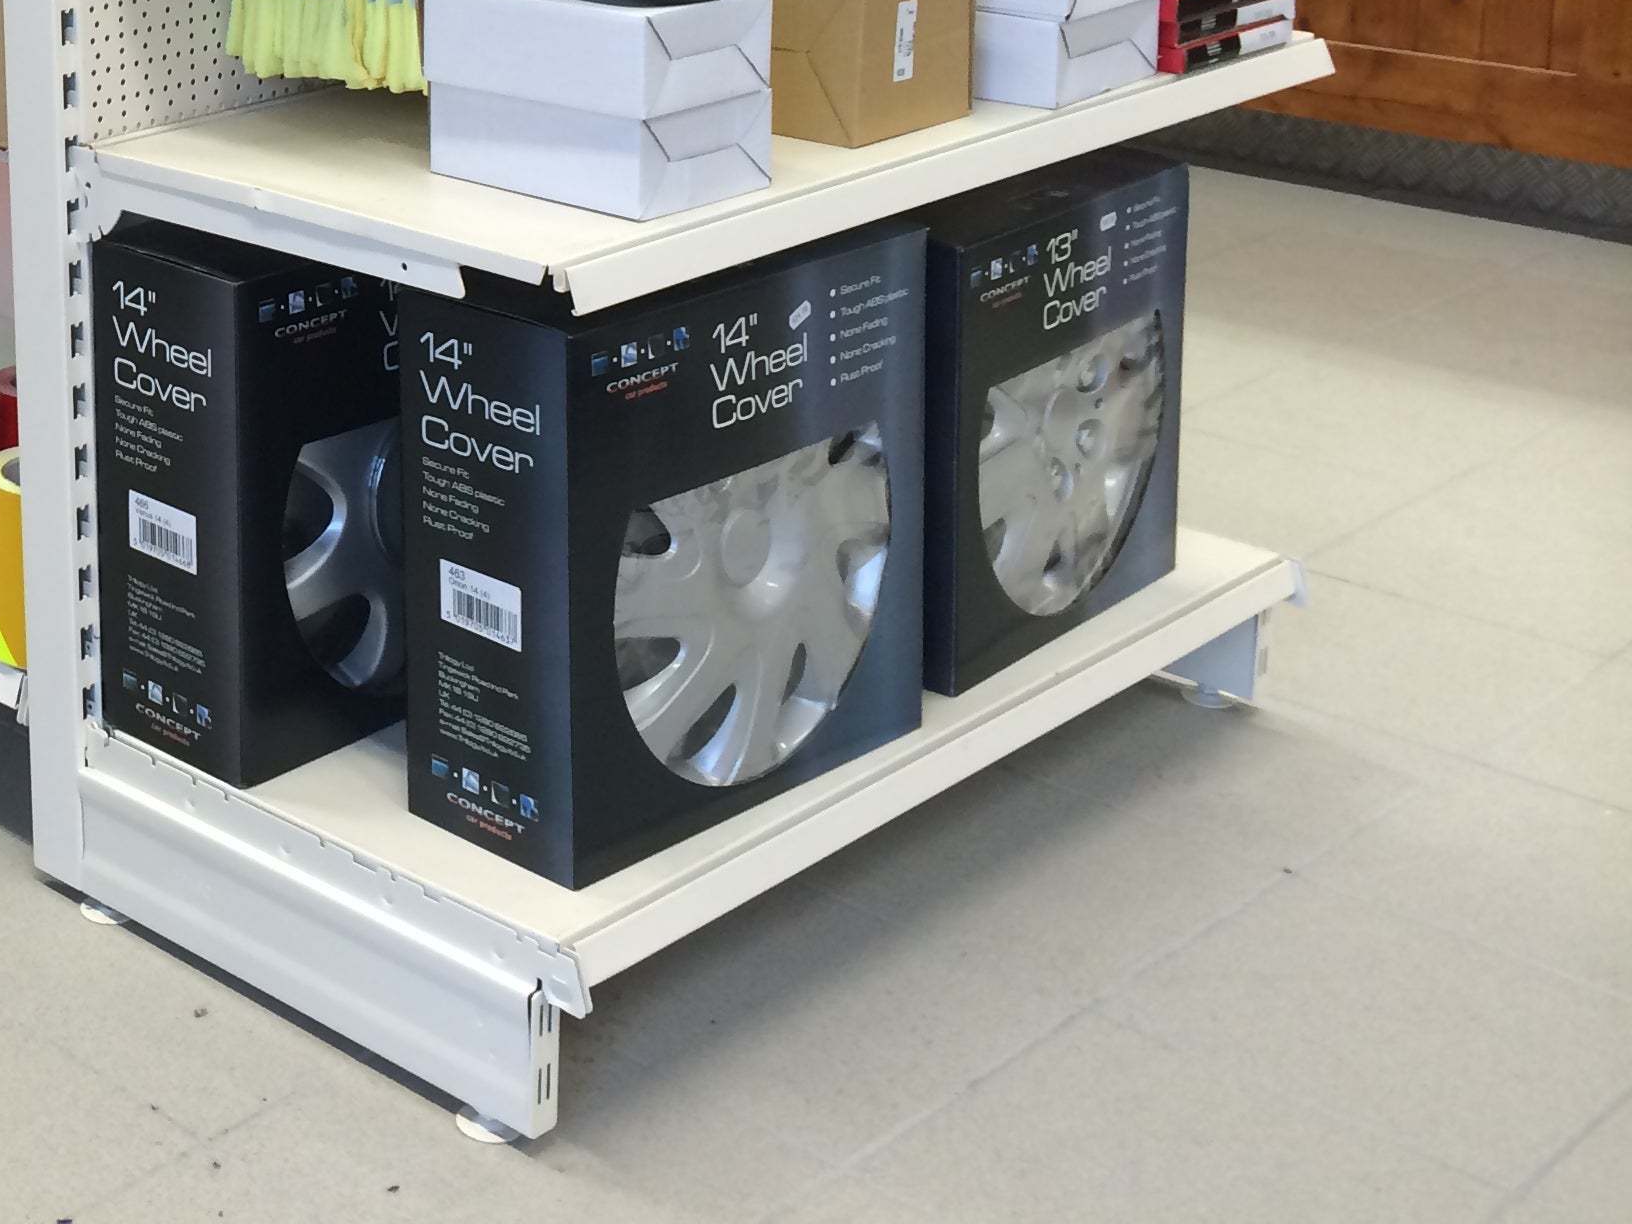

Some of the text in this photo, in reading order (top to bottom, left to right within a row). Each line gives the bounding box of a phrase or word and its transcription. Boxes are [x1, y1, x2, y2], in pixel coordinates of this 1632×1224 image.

[1043, 245, 1112, 297] Wheel
[111, 280, 157, 317] 14"
[1043, 285, 1108, 330] Cover
[111, 314, 212, 378] Wheel
[274, 309, 348, 338] CONCEPT
[711, 312, 758, 354] 14"
[419, 331, 473, 370] 14"
[709, 332, 808, 392] Wheel
[113, 356, 207, 412] Cover
[606, 362, 679, 394] CONCEPT
[419, 369, 541, 436] Wheel
[711, 378, 804, 429] Cover
[421, 414, 534, 474] Cover
[135, 702, 202, 741] CONCEPT
[446, 792, 526, 834] CONCEPT
